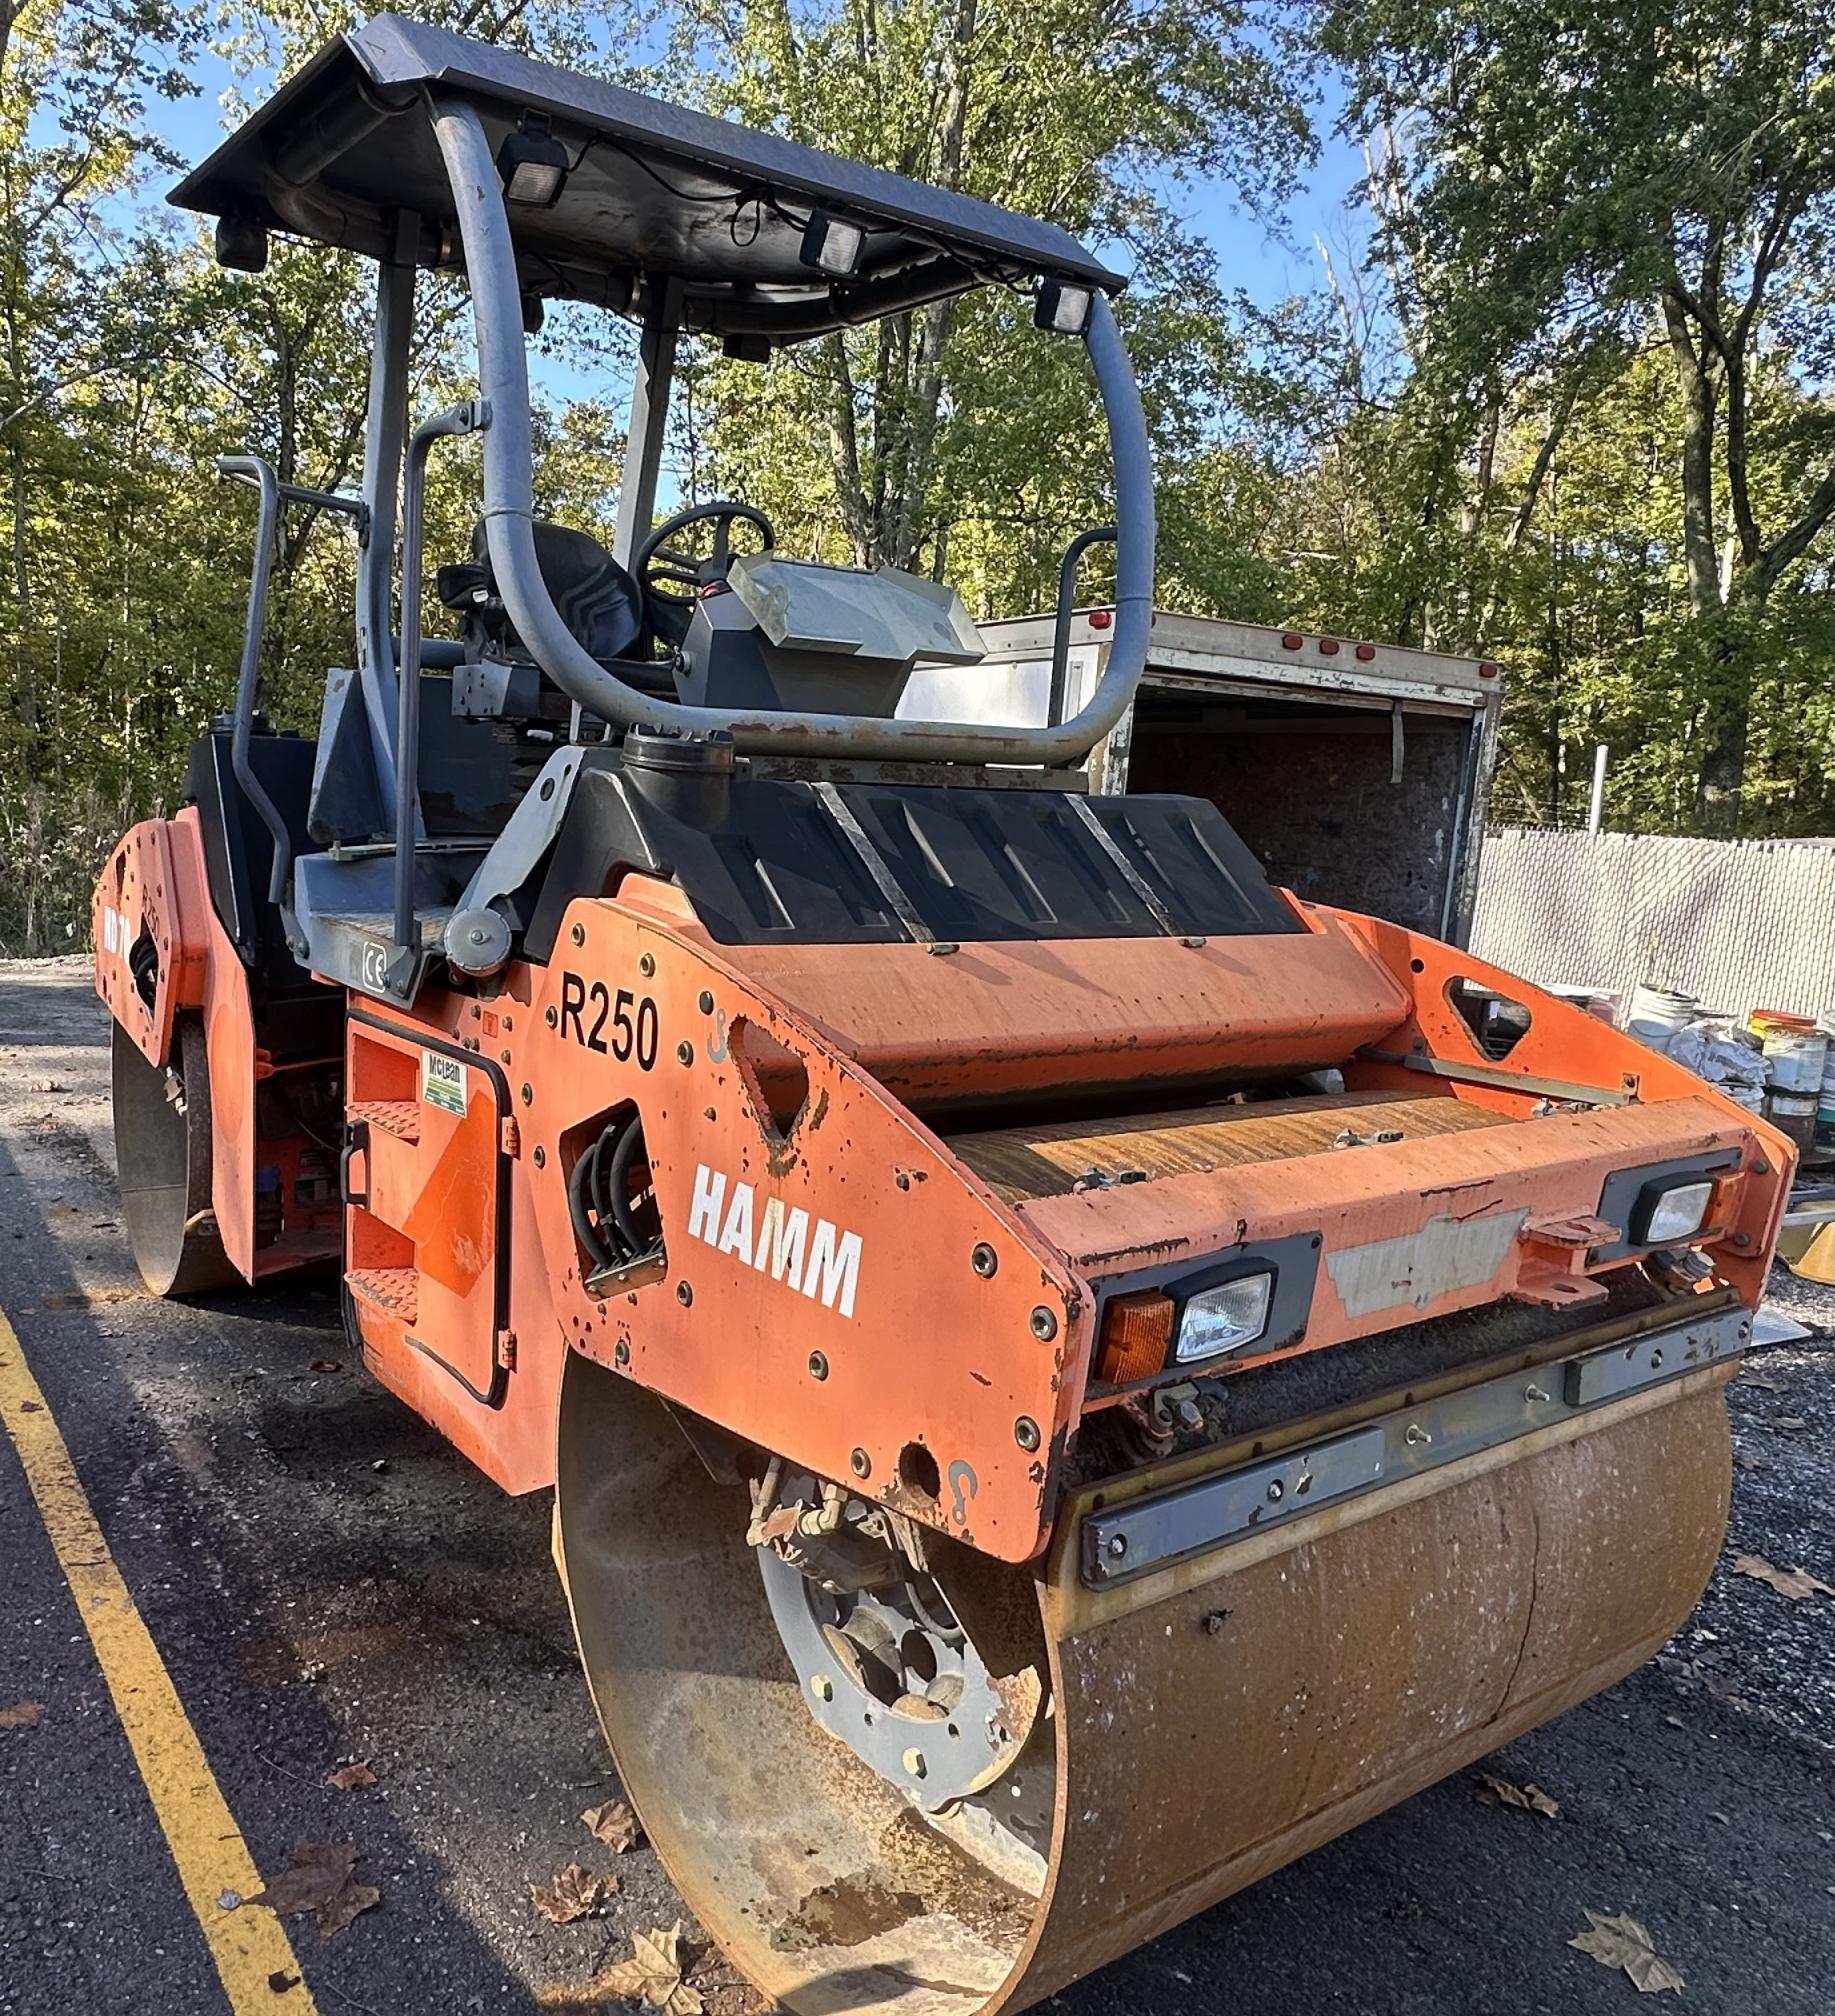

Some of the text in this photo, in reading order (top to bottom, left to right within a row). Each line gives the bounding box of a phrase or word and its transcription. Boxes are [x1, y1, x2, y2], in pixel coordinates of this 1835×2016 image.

[366, 950, 384, 986] CE
[561, 971, 658, 1072] R250
[688, 1163, 863, 1319] HAMM
